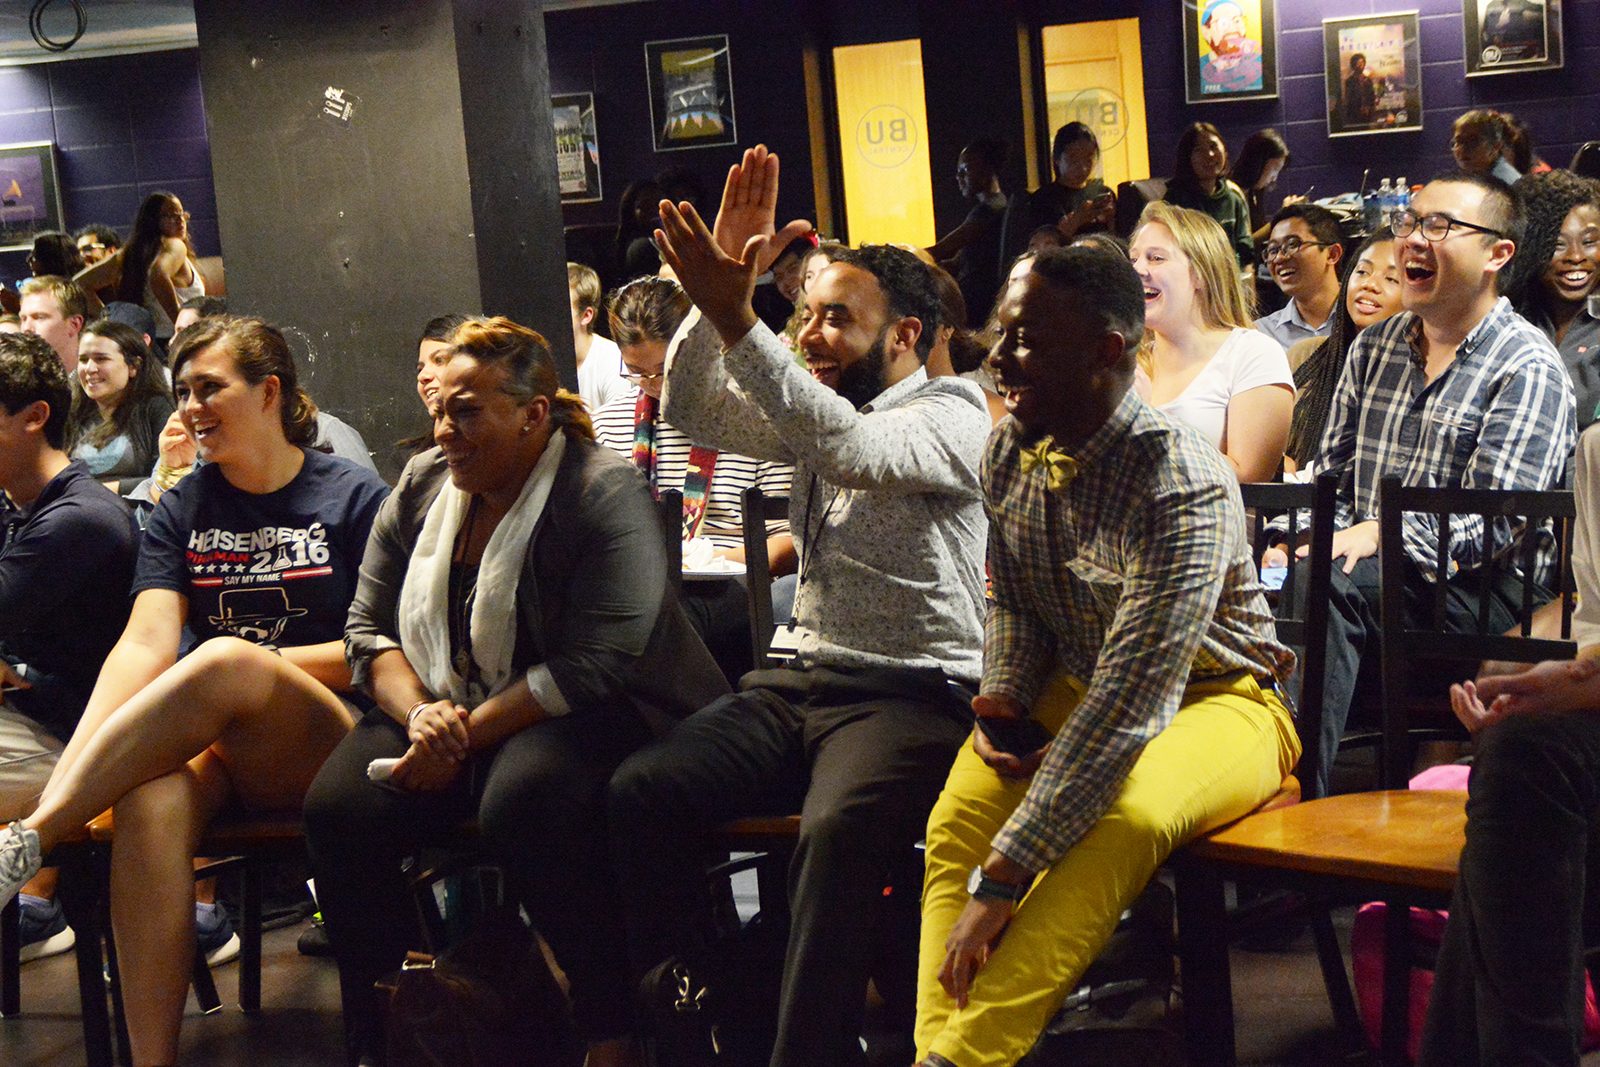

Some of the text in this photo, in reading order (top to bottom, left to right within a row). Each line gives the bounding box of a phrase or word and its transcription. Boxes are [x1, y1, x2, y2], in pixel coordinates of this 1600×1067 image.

[187, 522, 326, 553] HEISENBERG
[224, 572, 281, 586] SAY MY NAME
